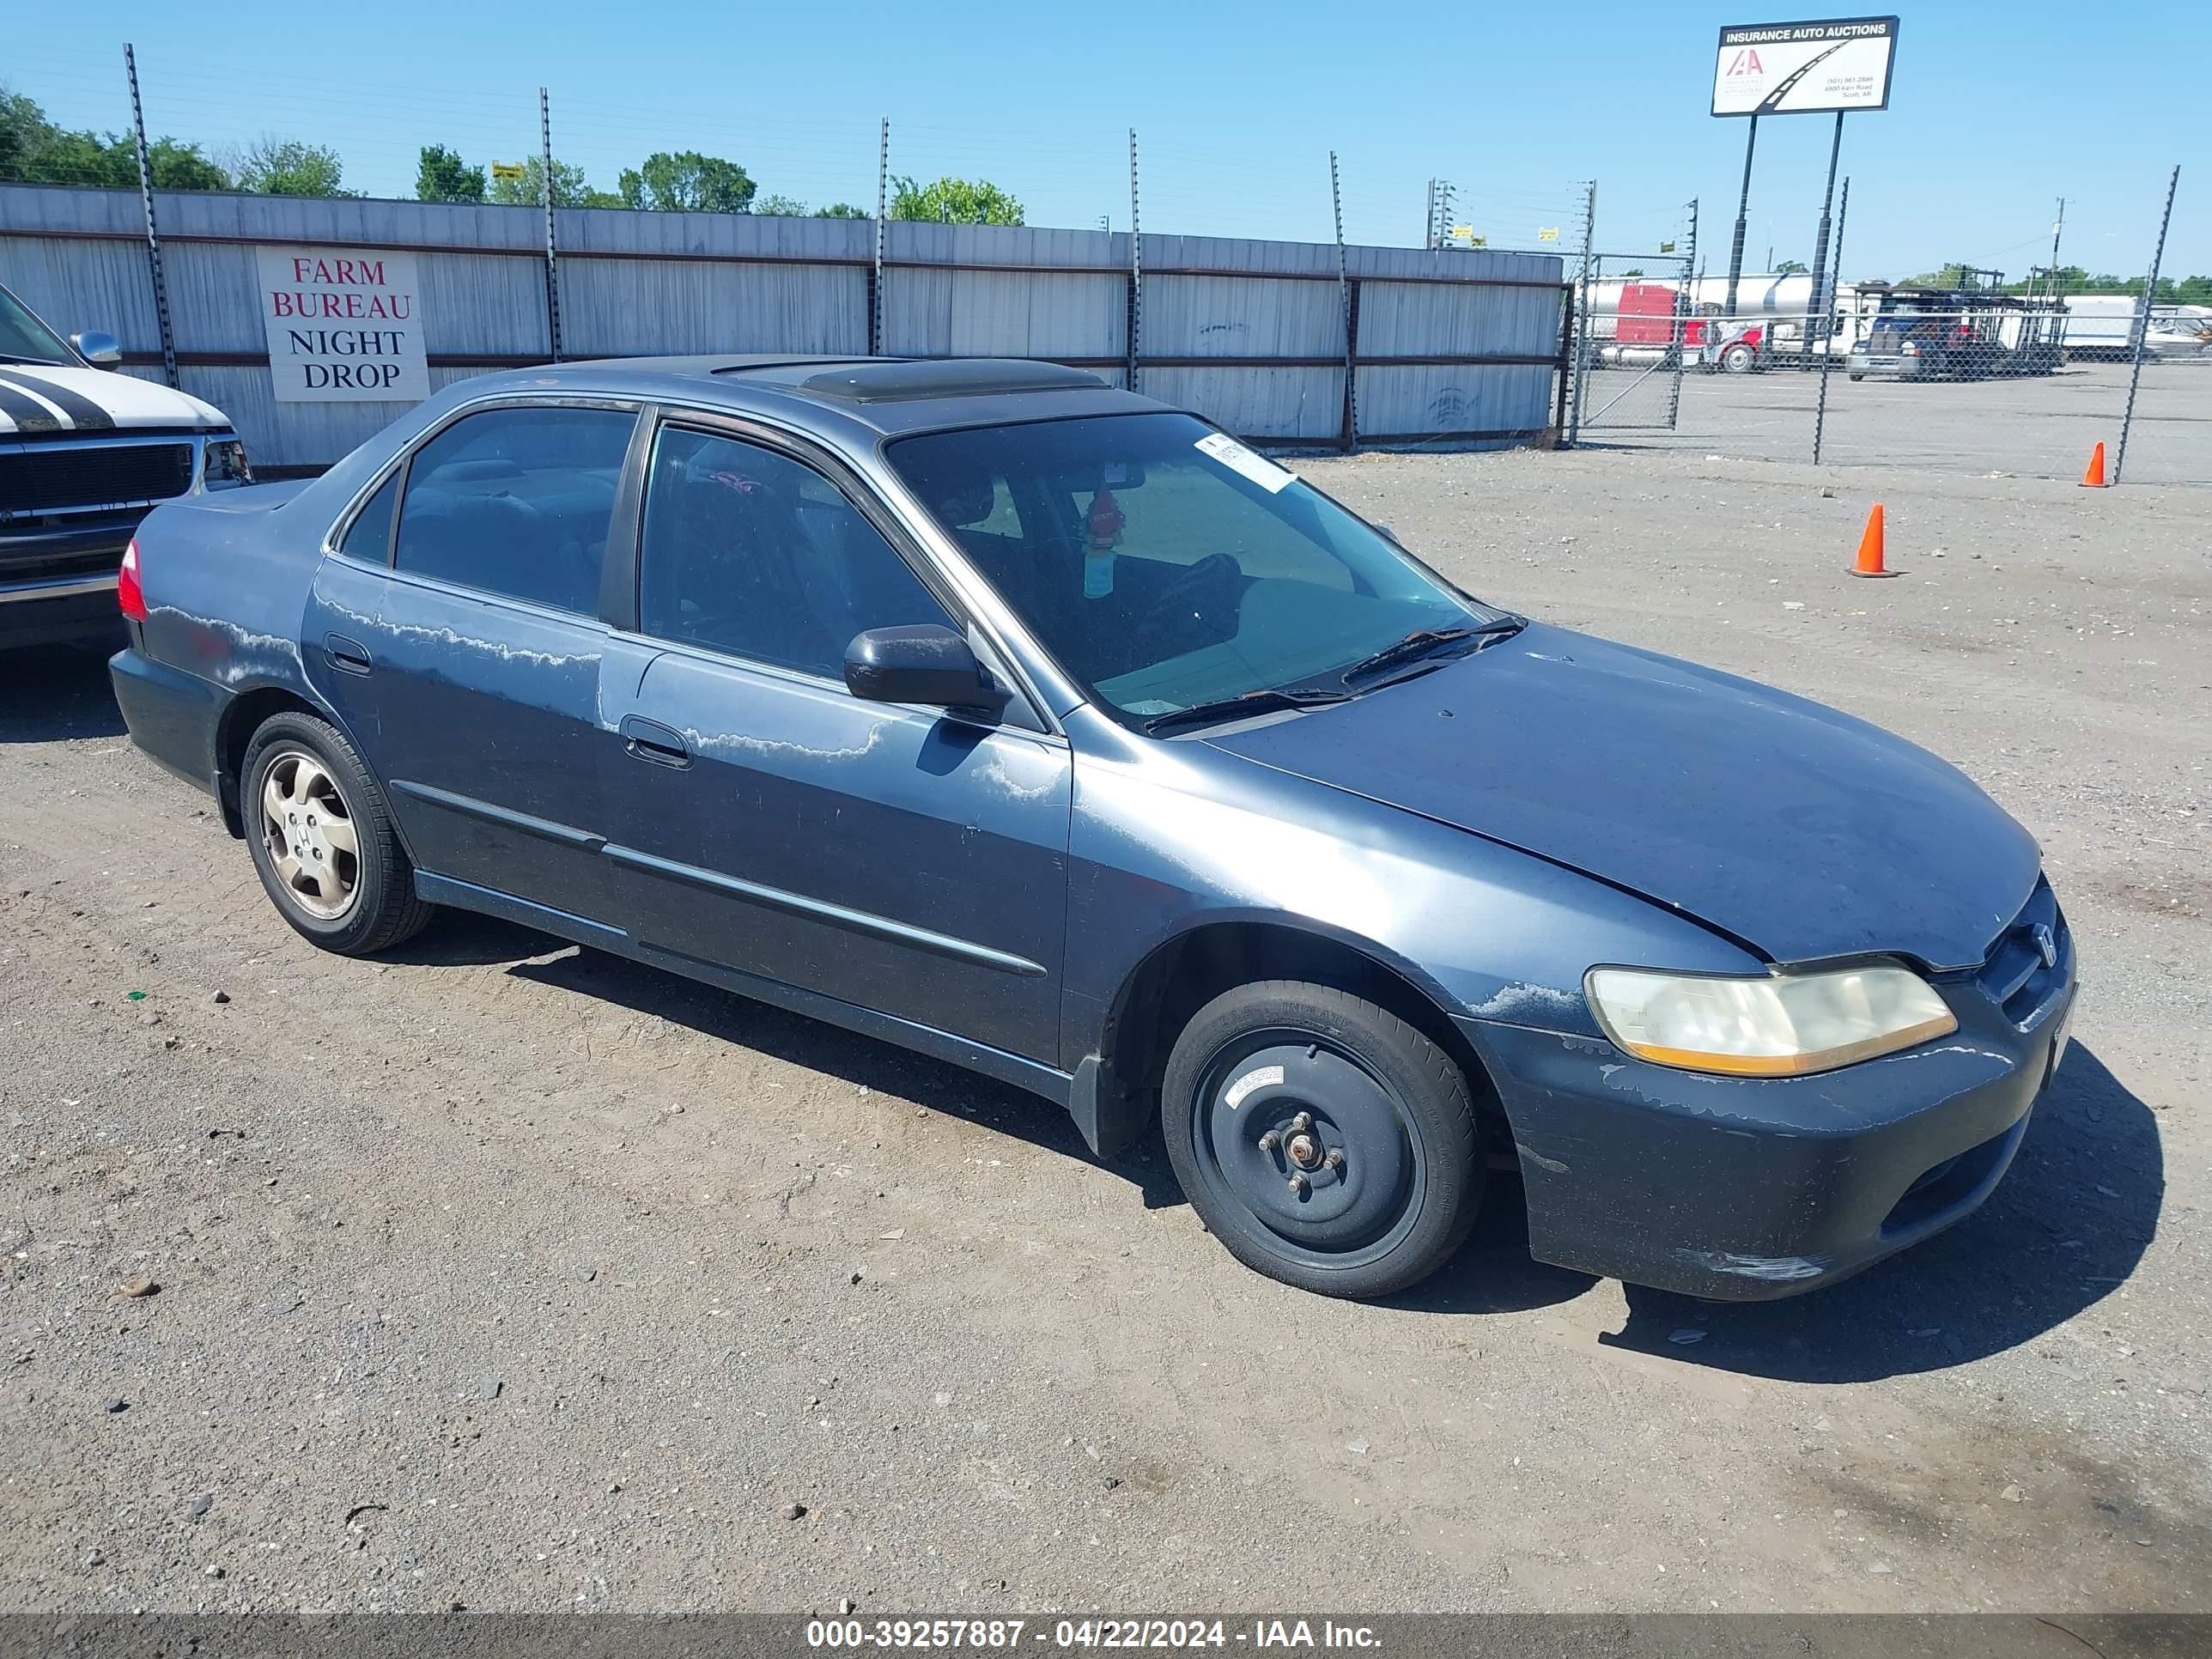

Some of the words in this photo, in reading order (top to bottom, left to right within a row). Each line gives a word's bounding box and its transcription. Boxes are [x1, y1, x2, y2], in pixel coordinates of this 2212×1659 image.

[1726, 30, 1791, 43] INSURANCE
[1793, 27, 1825, 39] AUTO
[1826, 24, 1886, 37] AUCTIONS
[291, 258, 386, 286] FARM
[270, 291, 411, 319] BUREAU
[288, 330, 405, 356] NIGHT
[302, 363, 400, 389] DROP
